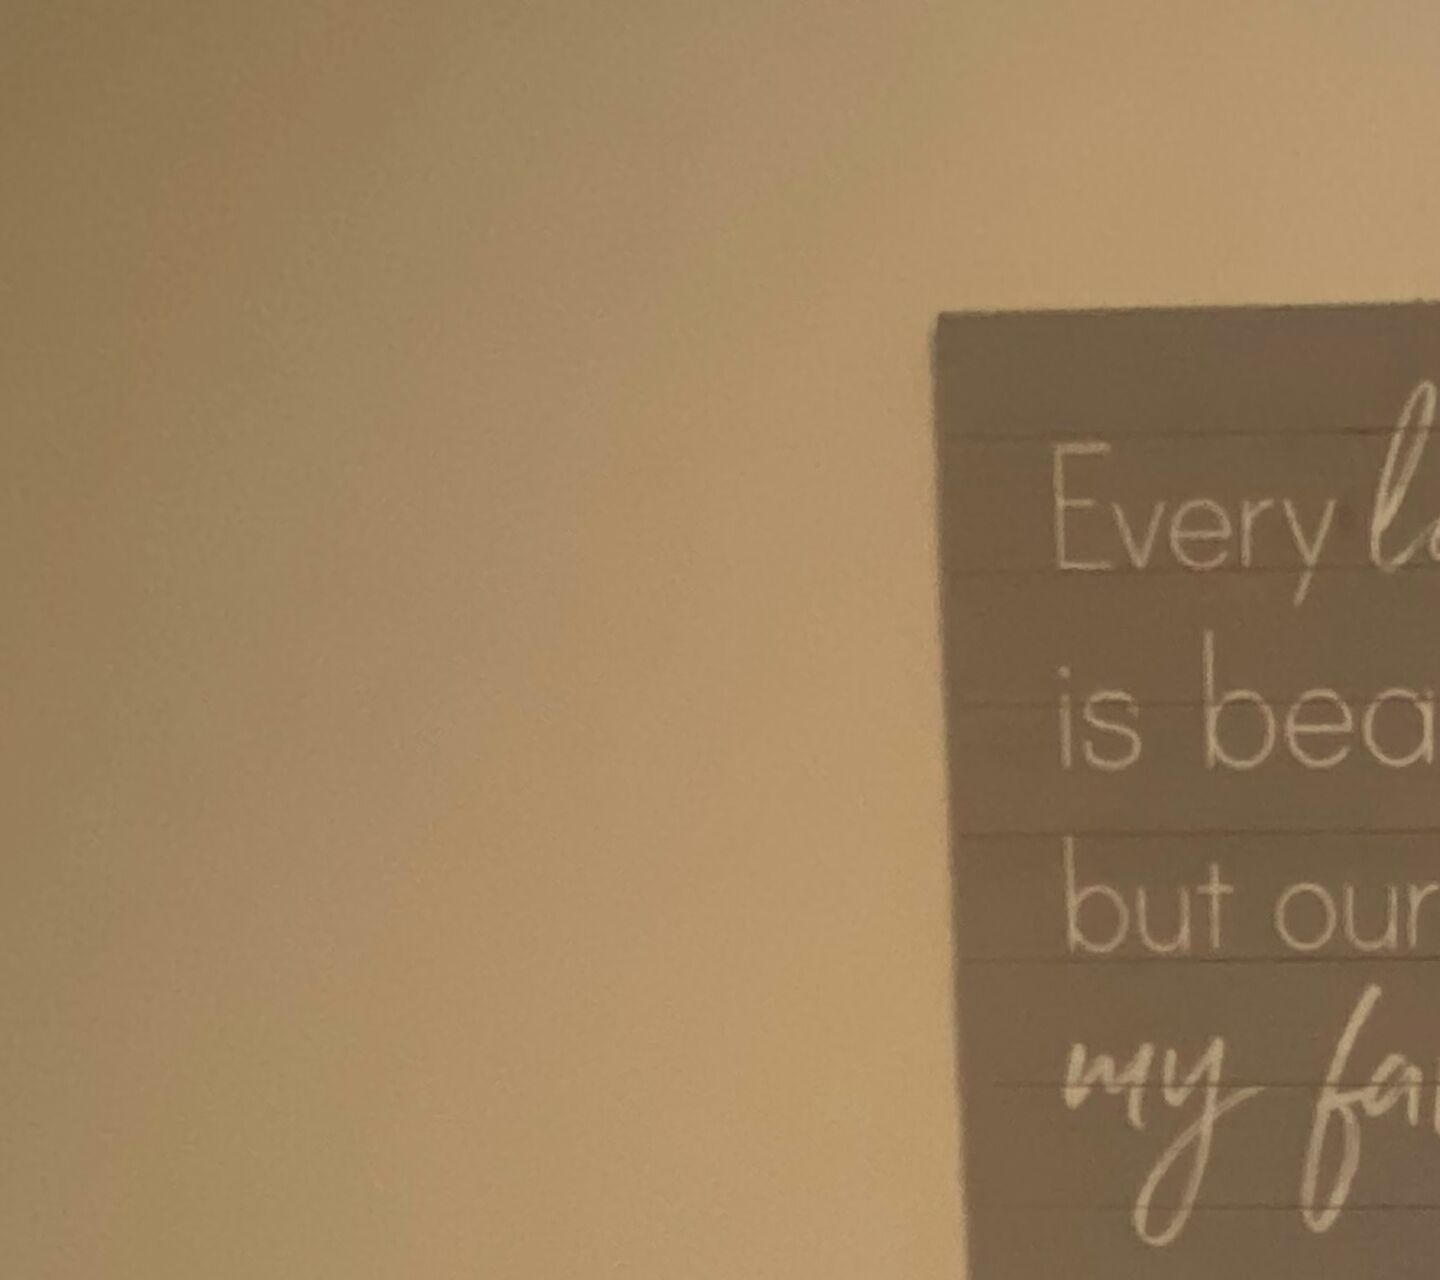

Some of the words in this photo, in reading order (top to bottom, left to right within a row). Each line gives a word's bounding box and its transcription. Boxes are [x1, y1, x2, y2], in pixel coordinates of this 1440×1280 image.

[1050, 440, 1338, 606] Every
[1057, 665, 1144, 770] is
[1062, 835, 1234, 955] but
[1064, 1032, 1263, 1247] my
